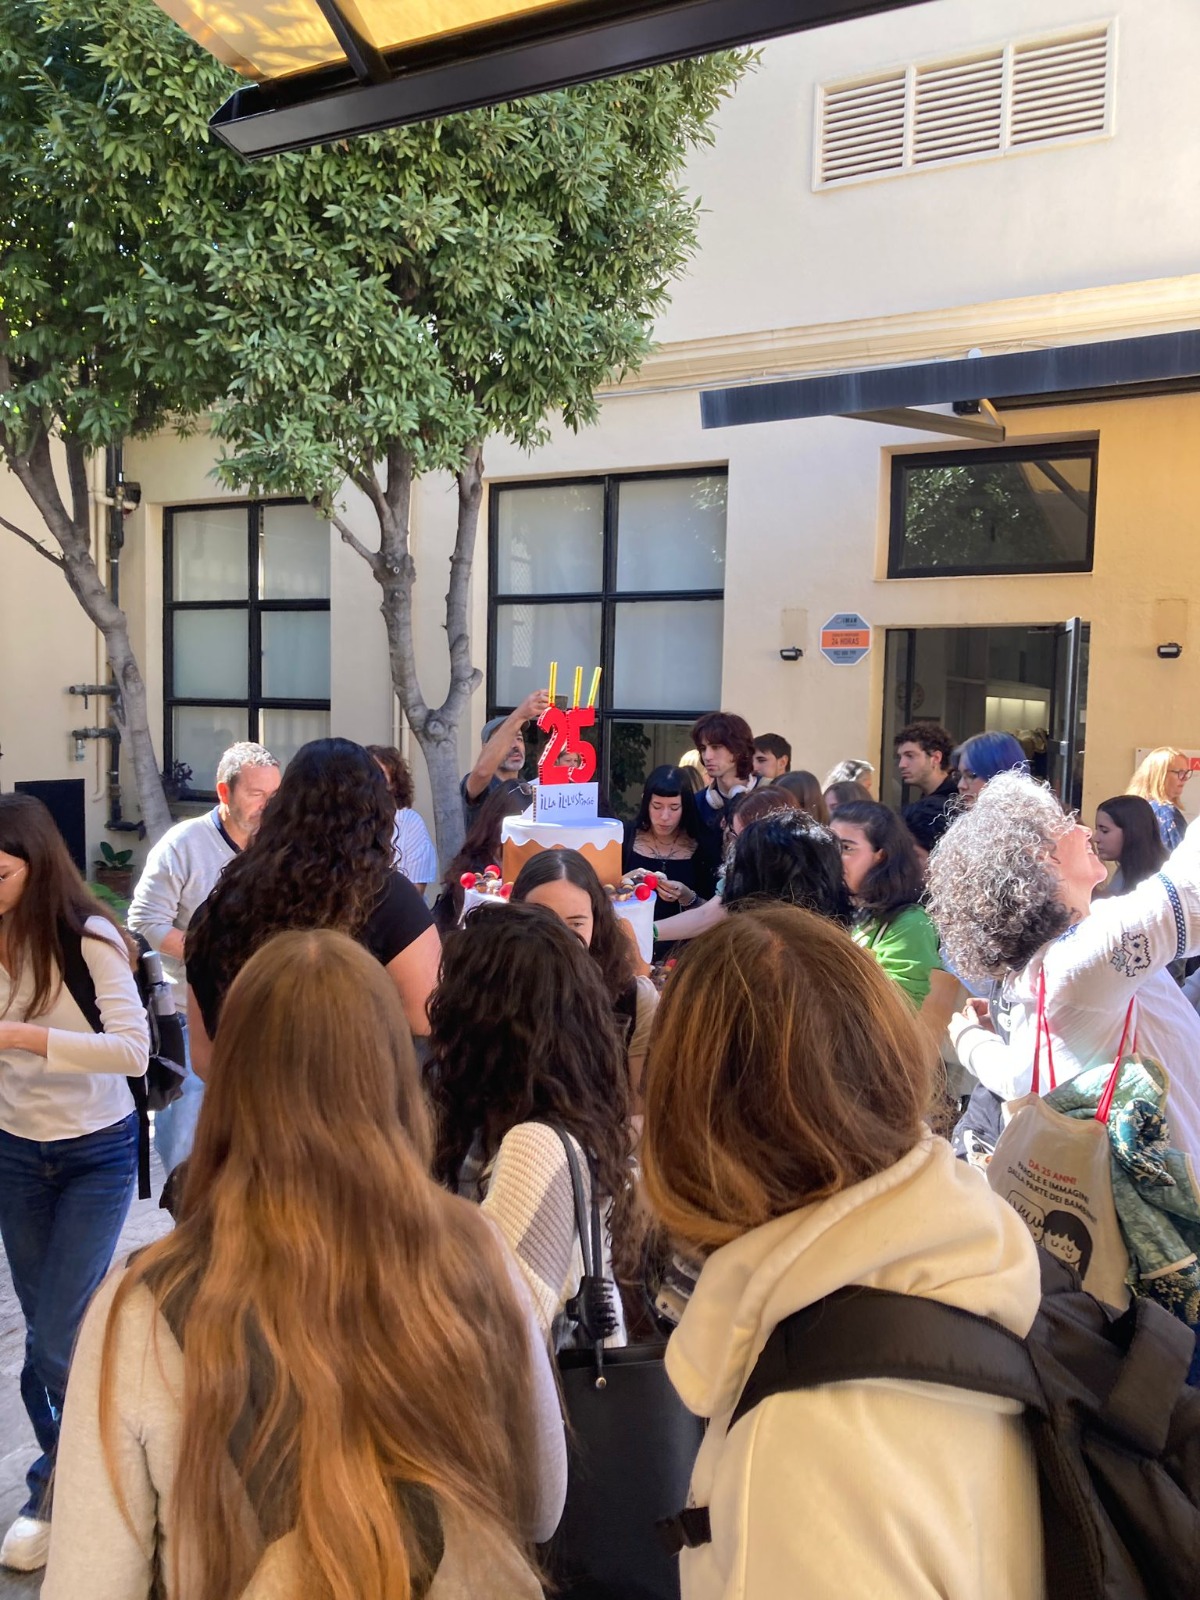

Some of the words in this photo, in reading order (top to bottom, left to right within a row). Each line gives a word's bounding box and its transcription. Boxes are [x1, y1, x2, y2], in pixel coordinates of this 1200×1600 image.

[840, 637, 859, 645] HORAS
[537, 706, 596, 785] 25
[1007, 1166, 1025, 1184] DALLA
[1026, 1180, 1049, 1198] PARTE
[1049, 1193, 1063, 1204] DEI
[1018, 1161, 1041, 1184] PAROLE
[1042, 1179, 1048, 1187] E
[1049, 1181, 1090, 1205] IMMAGINI
[1028, 1159, 1040, 1172] DA
[1042, 1167, 1051, 1177] 25
[1052, 1172, 1077, 1185] ANNI
